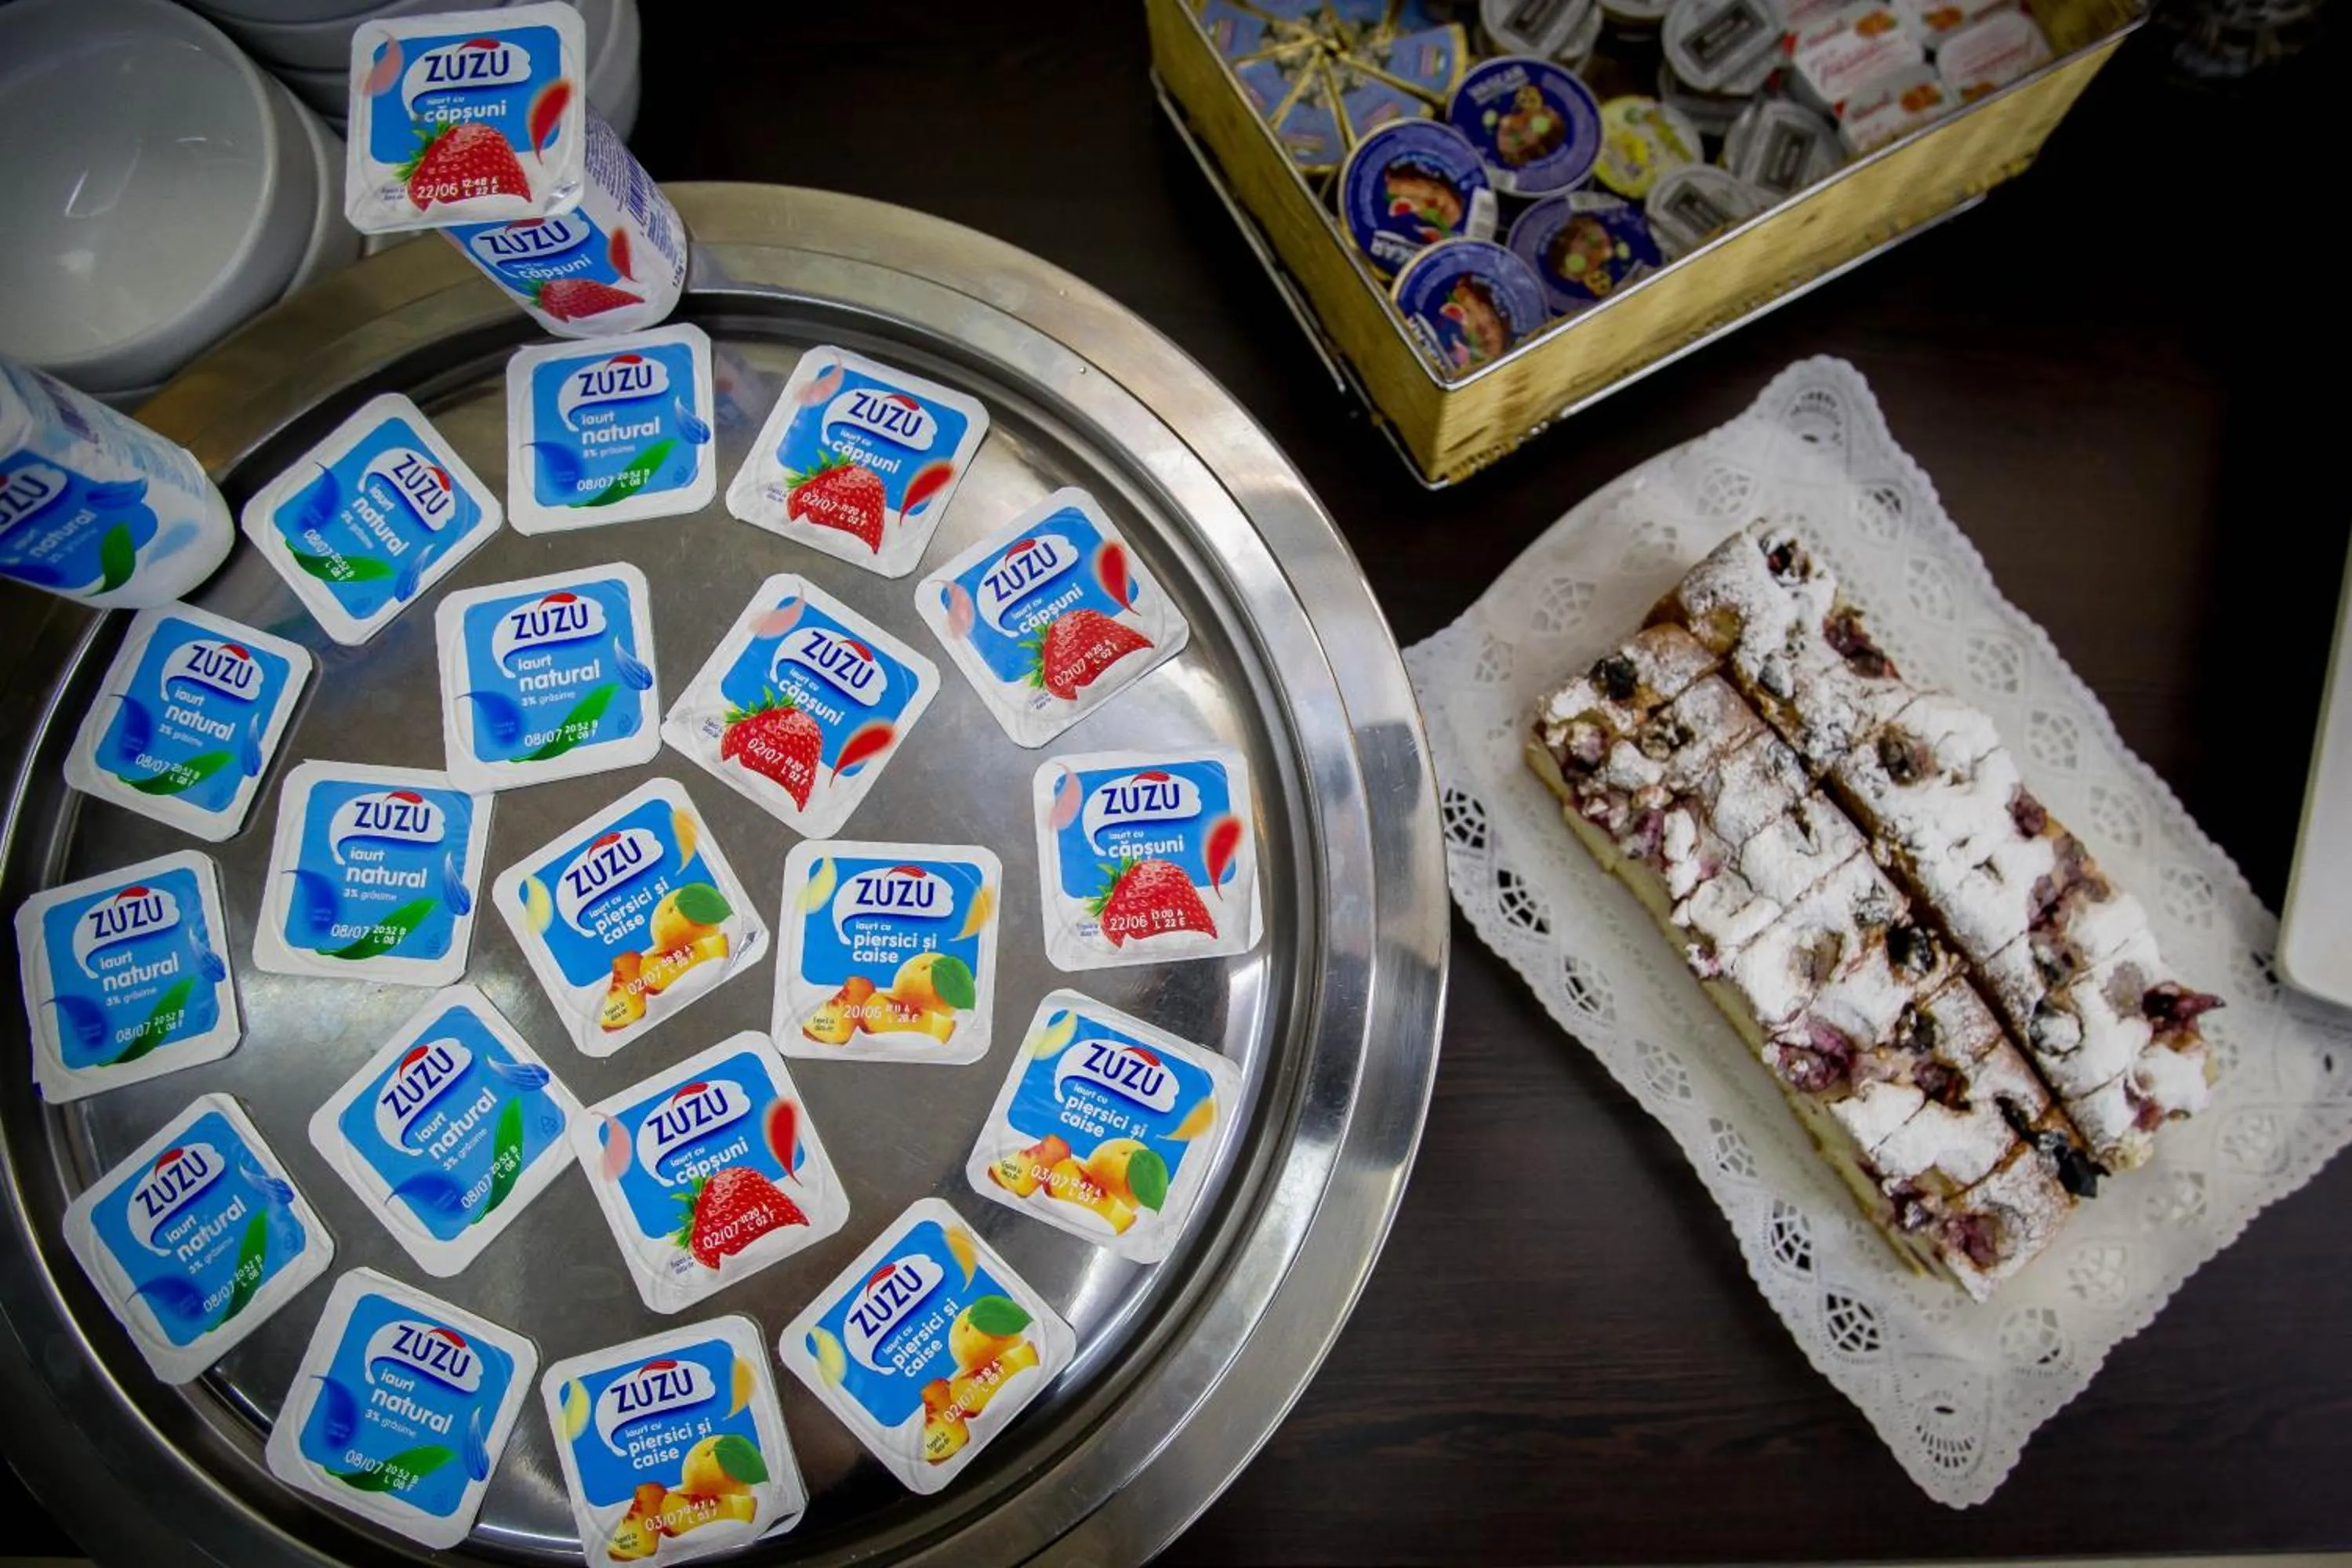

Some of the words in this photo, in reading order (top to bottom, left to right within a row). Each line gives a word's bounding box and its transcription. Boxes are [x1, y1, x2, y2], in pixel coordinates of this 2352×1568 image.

[425, 50, 509, 82] ZUZU
[425, 100, 506, 123] căpșuni
[417, 183, 458, 199] 22/06
[479, 220, 571, 254] ZUZU
[579, 365, 652, 397] ZUZU
[581, 412, 615, 425] iaurt
[582, 416, 660, 445] natural
[848, 392, 923, 437] ZUZU
[832, 439, 901, 474] căpșuni
[392, 453, 449, 514] ZUZU
[0, 474, 50, 527] ZU
[354, 497, 411, 557] natural
[985, 542, 1058, 602] ZUZU
[511, 604, 587, 640] ZUZU
[1019, 583, 1084, 634] căpșuni
[186, 645, 253, 688] ZUZU
[517, 655, 552, 670] iaurt
[519, 659, 600, 691] natural
[801, 630, 875, 689] ZUZU
[175, 688, 205, 706] iaurt
[779, 679, 845, 726] căpșuni
[165, 705, 236, 741] natural
[524, 728, 562, 747] 08/07
[136, 753, 169, 772] 08/07
[747, 738, 782, 764] 02/07
[1102, 783, 1180, 815] ZUZU
[354, 801, 430, 833] ZUZU
[350, 847, 385, 862] iaurt
[1109, 834, 1184, 859] căpșuni
[346, 866, 426, 888] natural
[566, 837, 642, 898] ZUZU
[595, 887, 653, 935] piersici
[655, 877, 670, 898] și
[855, 879, 934, 908] ZUZU
[89, 895, 163, 939] ZUZU
[330, 924, 370, 939] 08/07
[602, 914, 644, 945] caise
[1109, 916, 1148, 931] 22/06
[852, 947, 898, 964] caise
[854, 933, 917, 949] piersici
[923, 934, 937, 952] și
[100, 951, 132, 970] iaurt
[103, 951, 179, 992] natural
[116, 1022, 151, 1043] 08/07
[382, 1047, 455, 1120] ZUZU
[1083, 1043, 1163, 1096] ZUZU
[415, 1111, 448, 1143] iaurt
[430, 1087, 498, 1160] natural
[648, 1087, 728, 1145] ZUZU
[1060, 1111, 1105, 1138] caise
[1065, 1095, 1129, 1130] piersici
[1131, 1122, 1148, 1141] și
[676, 1136, 749, 1185] căpșuni
[136, 1151, 208, 1218] ZUZU
[461, 1175, 493, 1209] 08/07
[165, 1214, 198, 1244] iaurt
[176, 1195, 247, 1261] natural
[702, 1221, 740, 1250] 02/07
[203, 1280, 235, 1312] 08/07
[850, 1265, 922, 1338] ZUZU
[892, 1312, 945, 1370] piersici
[944, 1298, 960, 1318] și
[392, 1325, 471, 1377] ZUZU
[903, 1338, 943, 1377] caise
[382, 1369, 415, 1391] iaurt
[610, 1368, 694, 1414] ZUZU
[372, 1388, 454, 1434] natural
[629, 1421, 692, 1457] piersici
[698, 1417, 712, 1438] și
[345, 1450, 383, 1474] 08/07
[633, 1446, 680, 1470] caise
